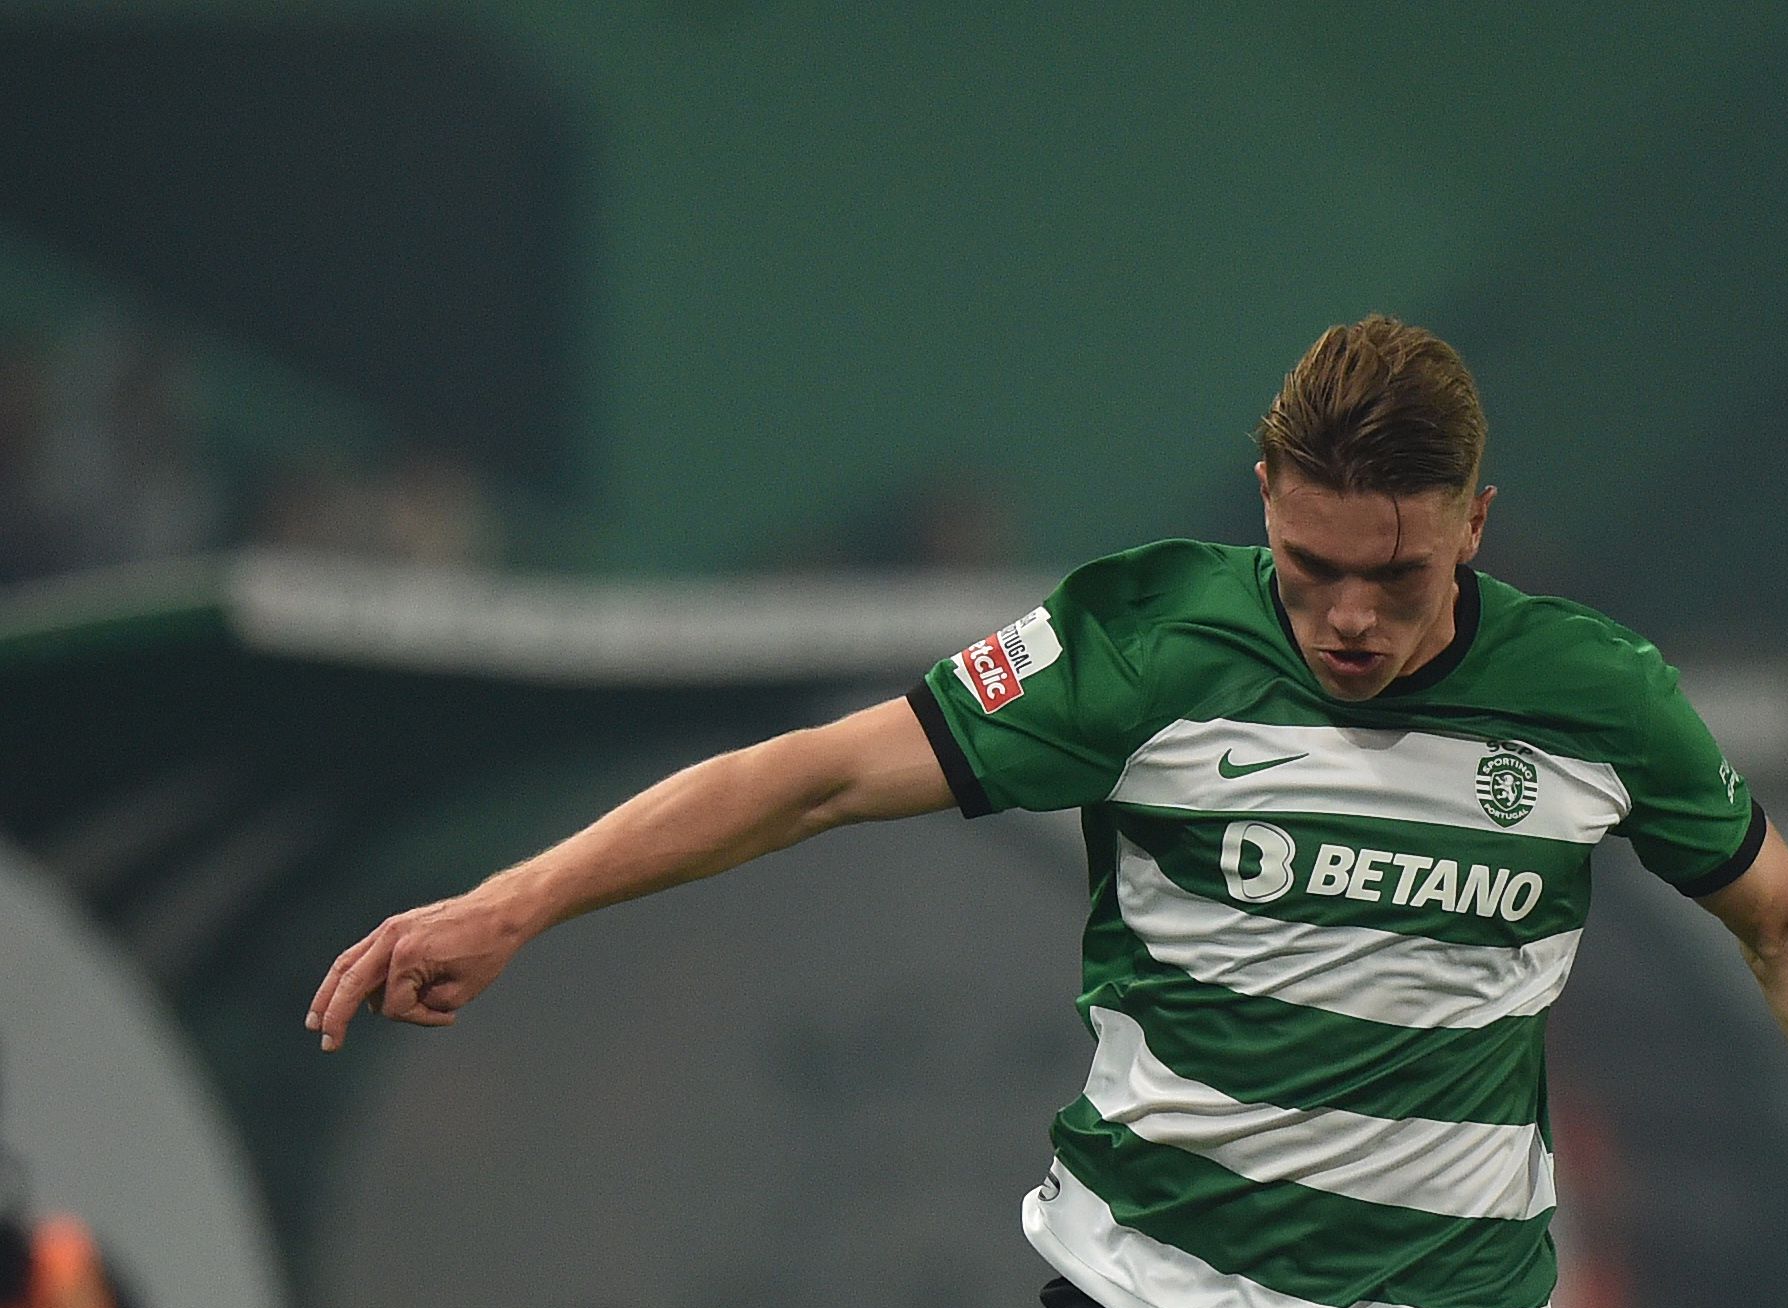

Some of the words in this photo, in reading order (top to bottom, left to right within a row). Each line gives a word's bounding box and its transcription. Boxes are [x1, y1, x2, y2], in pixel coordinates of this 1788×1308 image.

[1486, 740, 1533, 756] SCP
[1482, 757, 1533, 780] SPORTING
[1483, 803, 1529, 820] PORTUGAL
[1306, 843, 1544, 922] BETANO
